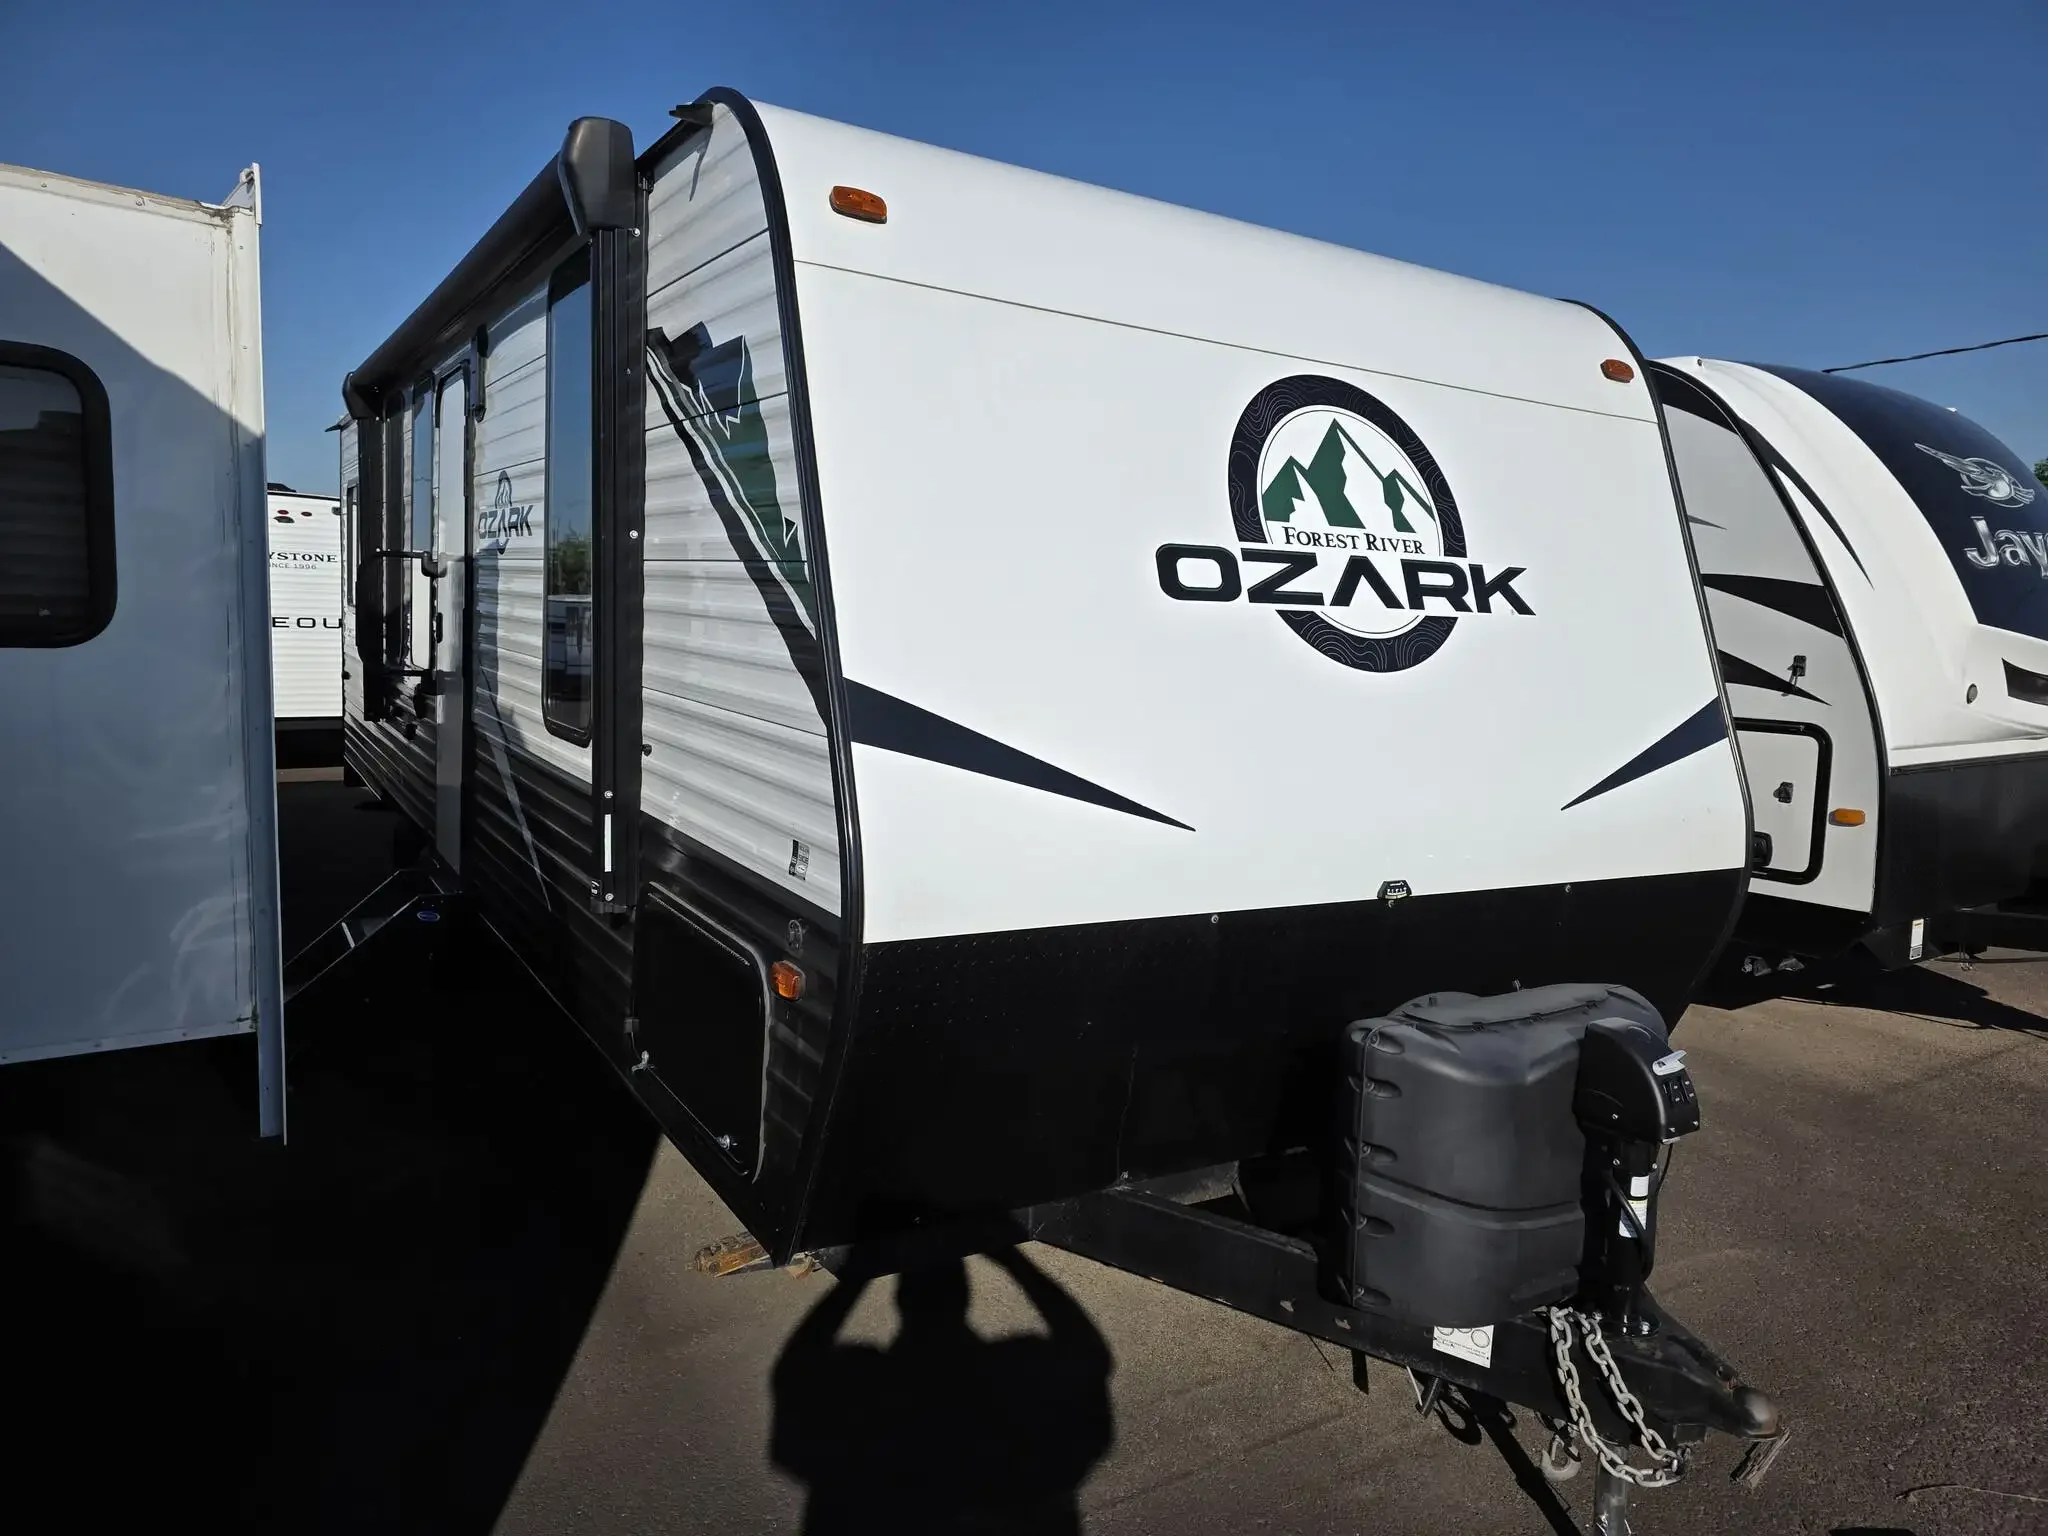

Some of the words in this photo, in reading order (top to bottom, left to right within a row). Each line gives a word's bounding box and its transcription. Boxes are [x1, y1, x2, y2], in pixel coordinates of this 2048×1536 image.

[478, 505, 534, 540] OZARK
[1282, 526, 1360, 550] FOREST
[1363, 532, 1426, 555] RIVER
[1962, 515, 2048, 580] Jay
[1155, 543, 1537, 616] OZARK
